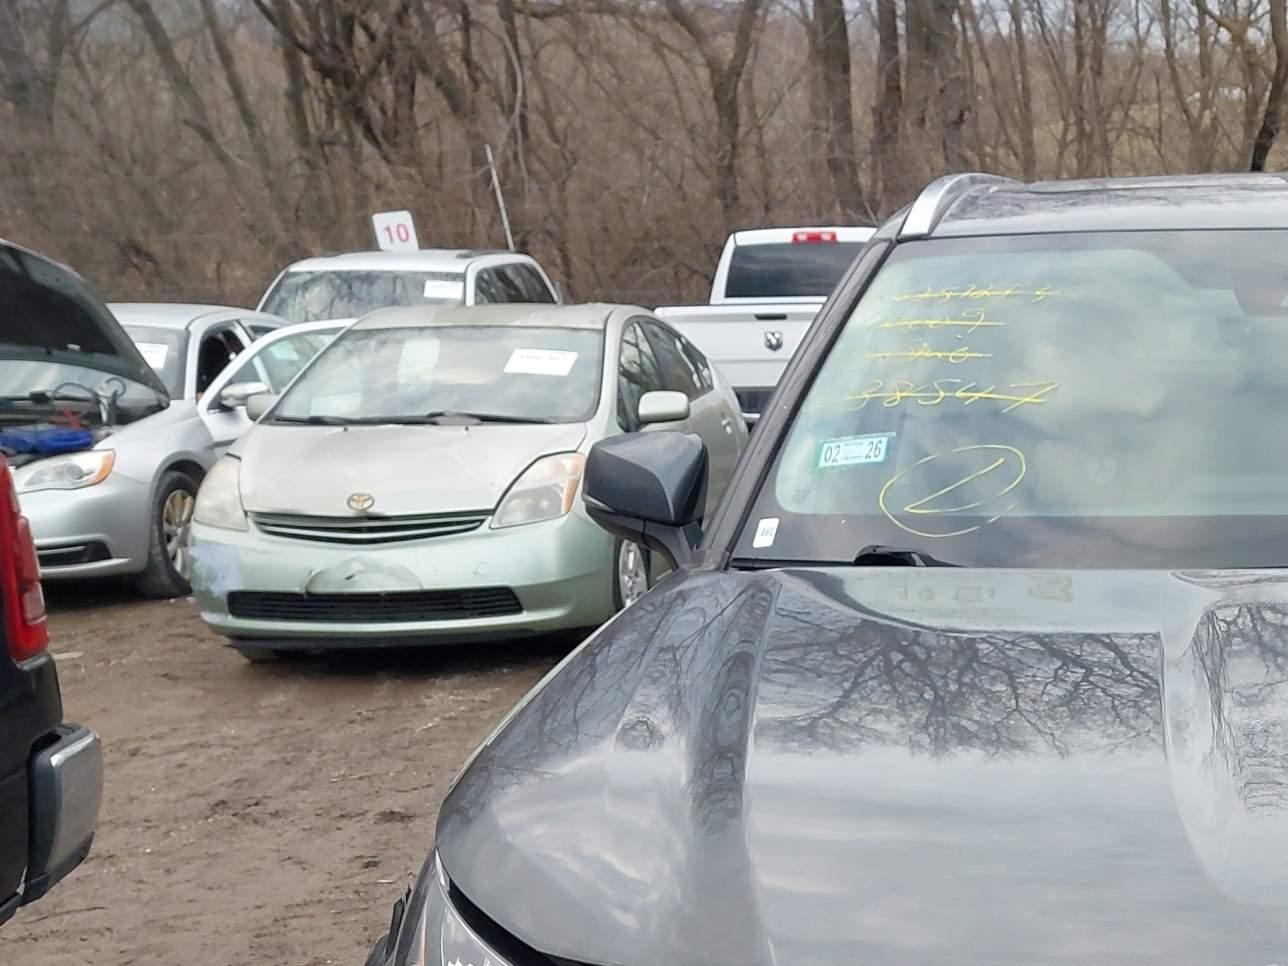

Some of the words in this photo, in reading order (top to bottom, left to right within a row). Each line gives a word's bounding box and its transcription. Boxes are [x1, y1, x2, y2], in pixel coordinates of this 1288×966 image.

[384, 223, 409, 244] 10
[824, 444, 841, 464] 02
[864, 440, 882, 460] 26
